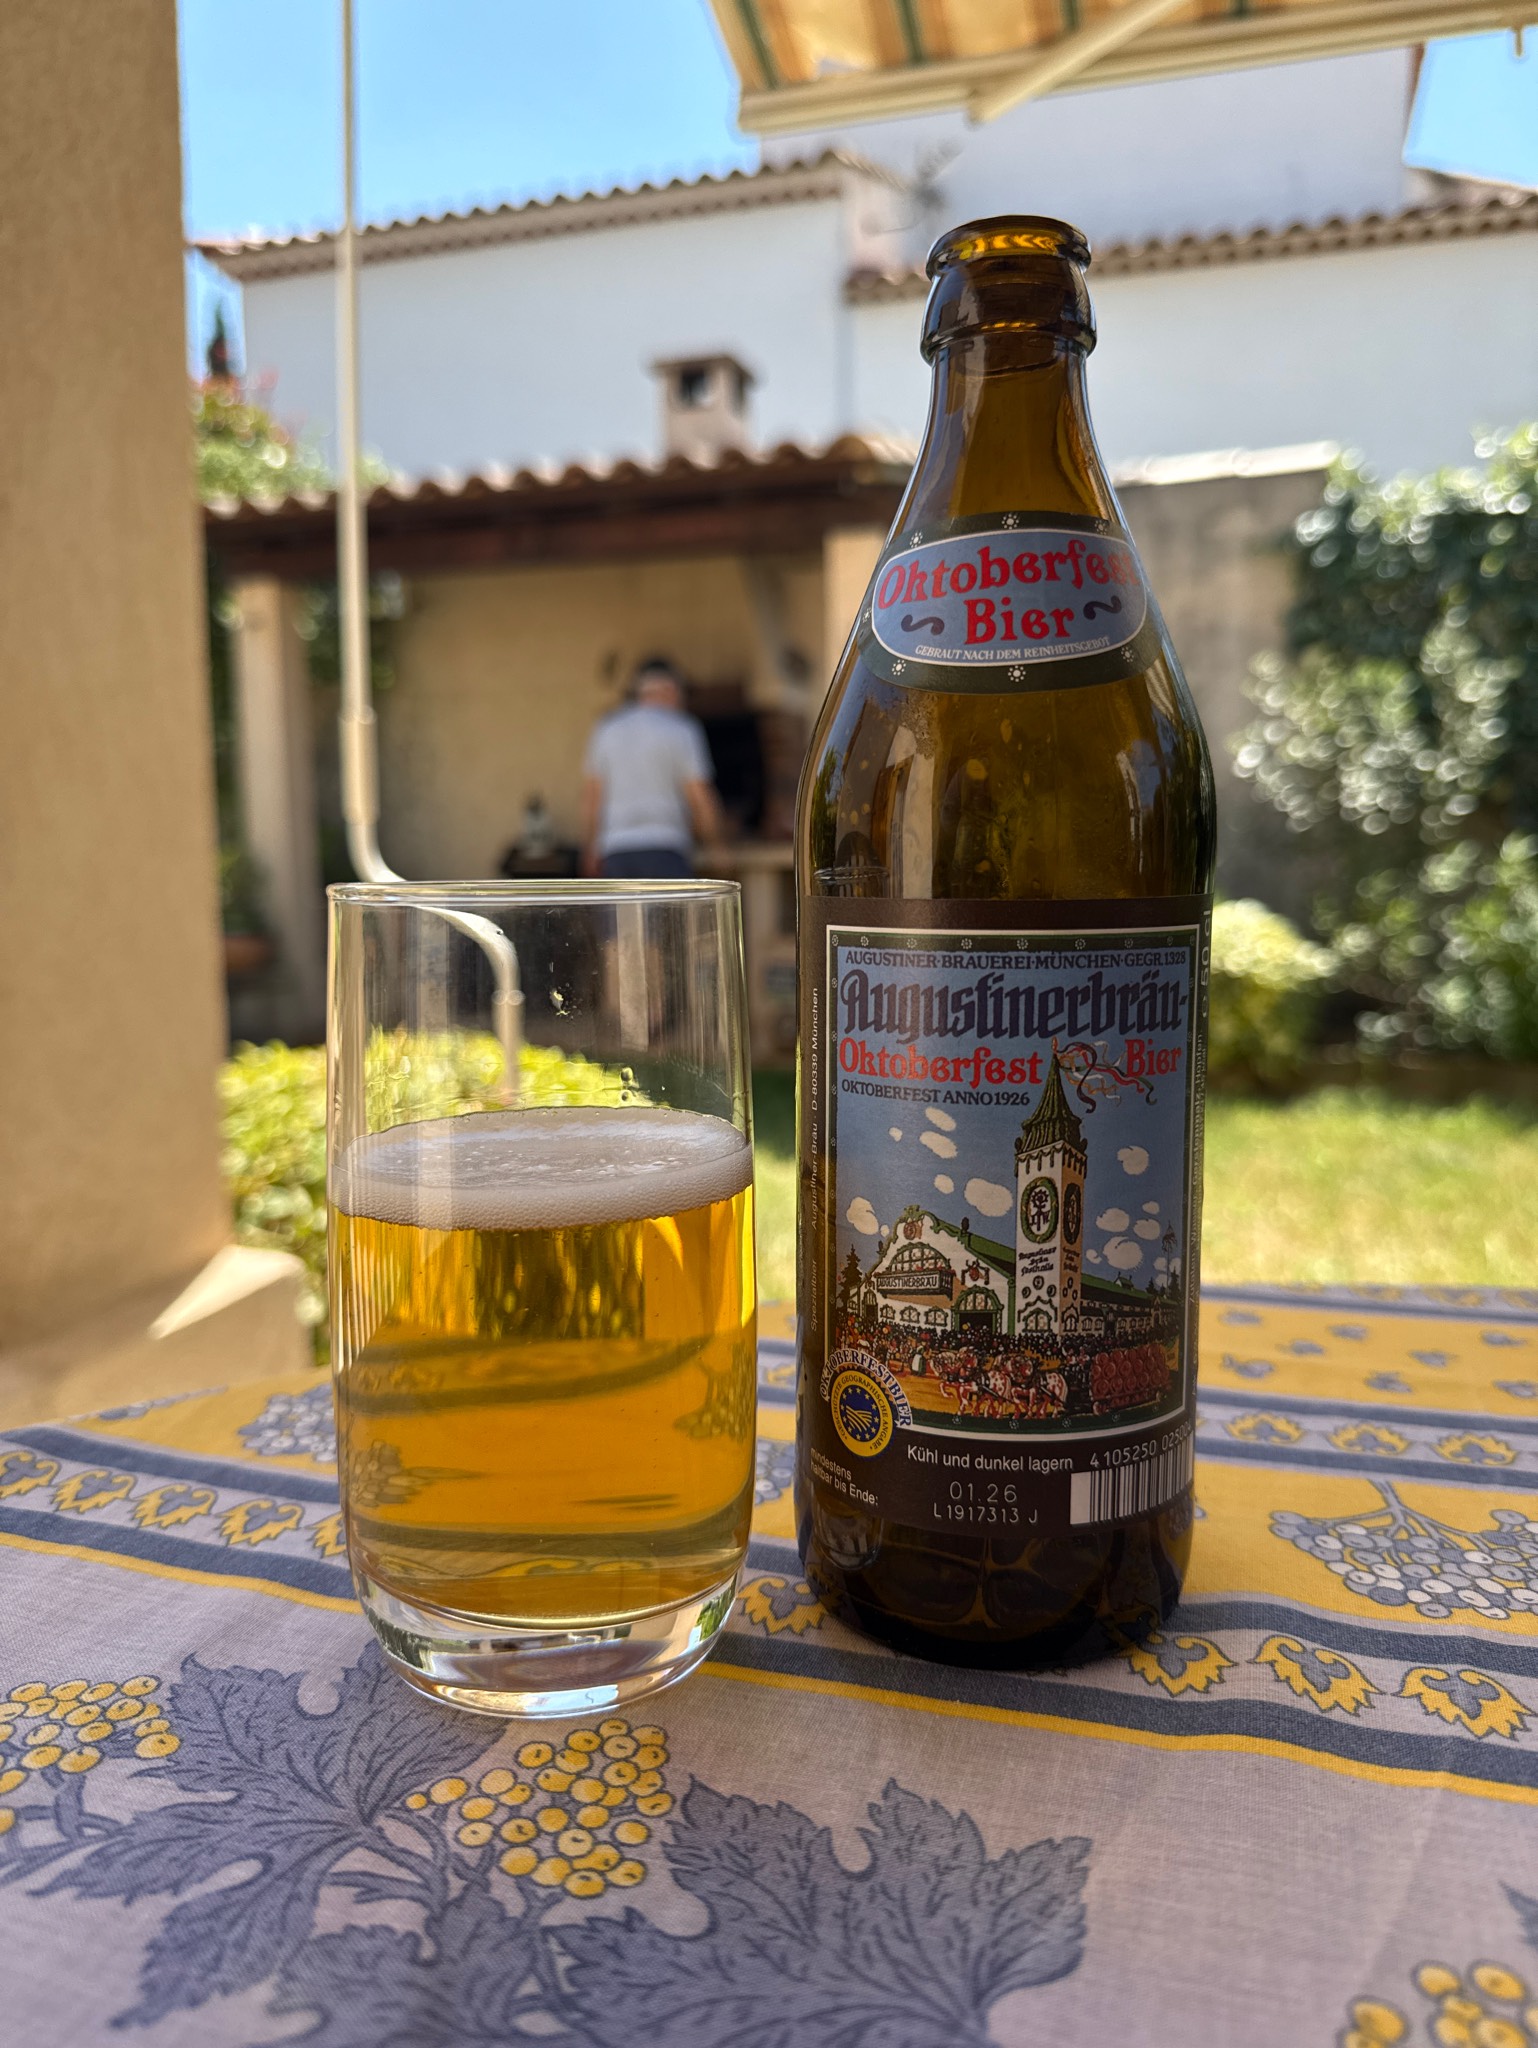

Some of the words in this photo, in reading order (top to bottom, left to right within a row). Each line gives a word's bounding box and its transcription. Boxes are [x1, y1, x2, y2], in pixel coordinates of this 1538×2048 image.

[878, 540, 1140, 610] Oktoberfest
[964, 597, 1075, 645] Bier
[915, 645, 961, 660] GEBRAUT
[963, 649, 994, 660] NACH
[996, 648, 1022, 660] DEM
[1024, 635, 1111, 658] REINHEITSGEBOT
[839, 1036, 1044, 1089] Oktoberfest
[1124, 1038, 1182, 1078] Bier
[841, 1078, 941, 1103] OKTOBERFEST
[993, 1091, 1030, 1107] 1926
[810, 1259, 818, 1331] Spezialbier
[821, 1350, 912, 1426] OKTOBERFESTBIER
[842, 1375, 888, 1418] GEOGRAPHISCHE
[873, 1420, 888, 1449] ANGABE
[810, 1448, 852, 1480] mindestens
[907, 1444, 938, 1464] Kühl
[943, 1453, 970, 1468] und
[975, 1455, 1023, 1471] dunkel
[1028, 1456, 1073, 1474] lagern
[1090, 1452, 1099, 1468] 4
[1103, 1440, 1157, 1467] 105250
[834, 1475, 847, 1492] bis
[849, 1483, 878, 1506] Ende:
[950, 1481, 1017, 1503] 01.26
[1028, 1508, 1038, 1524] J
